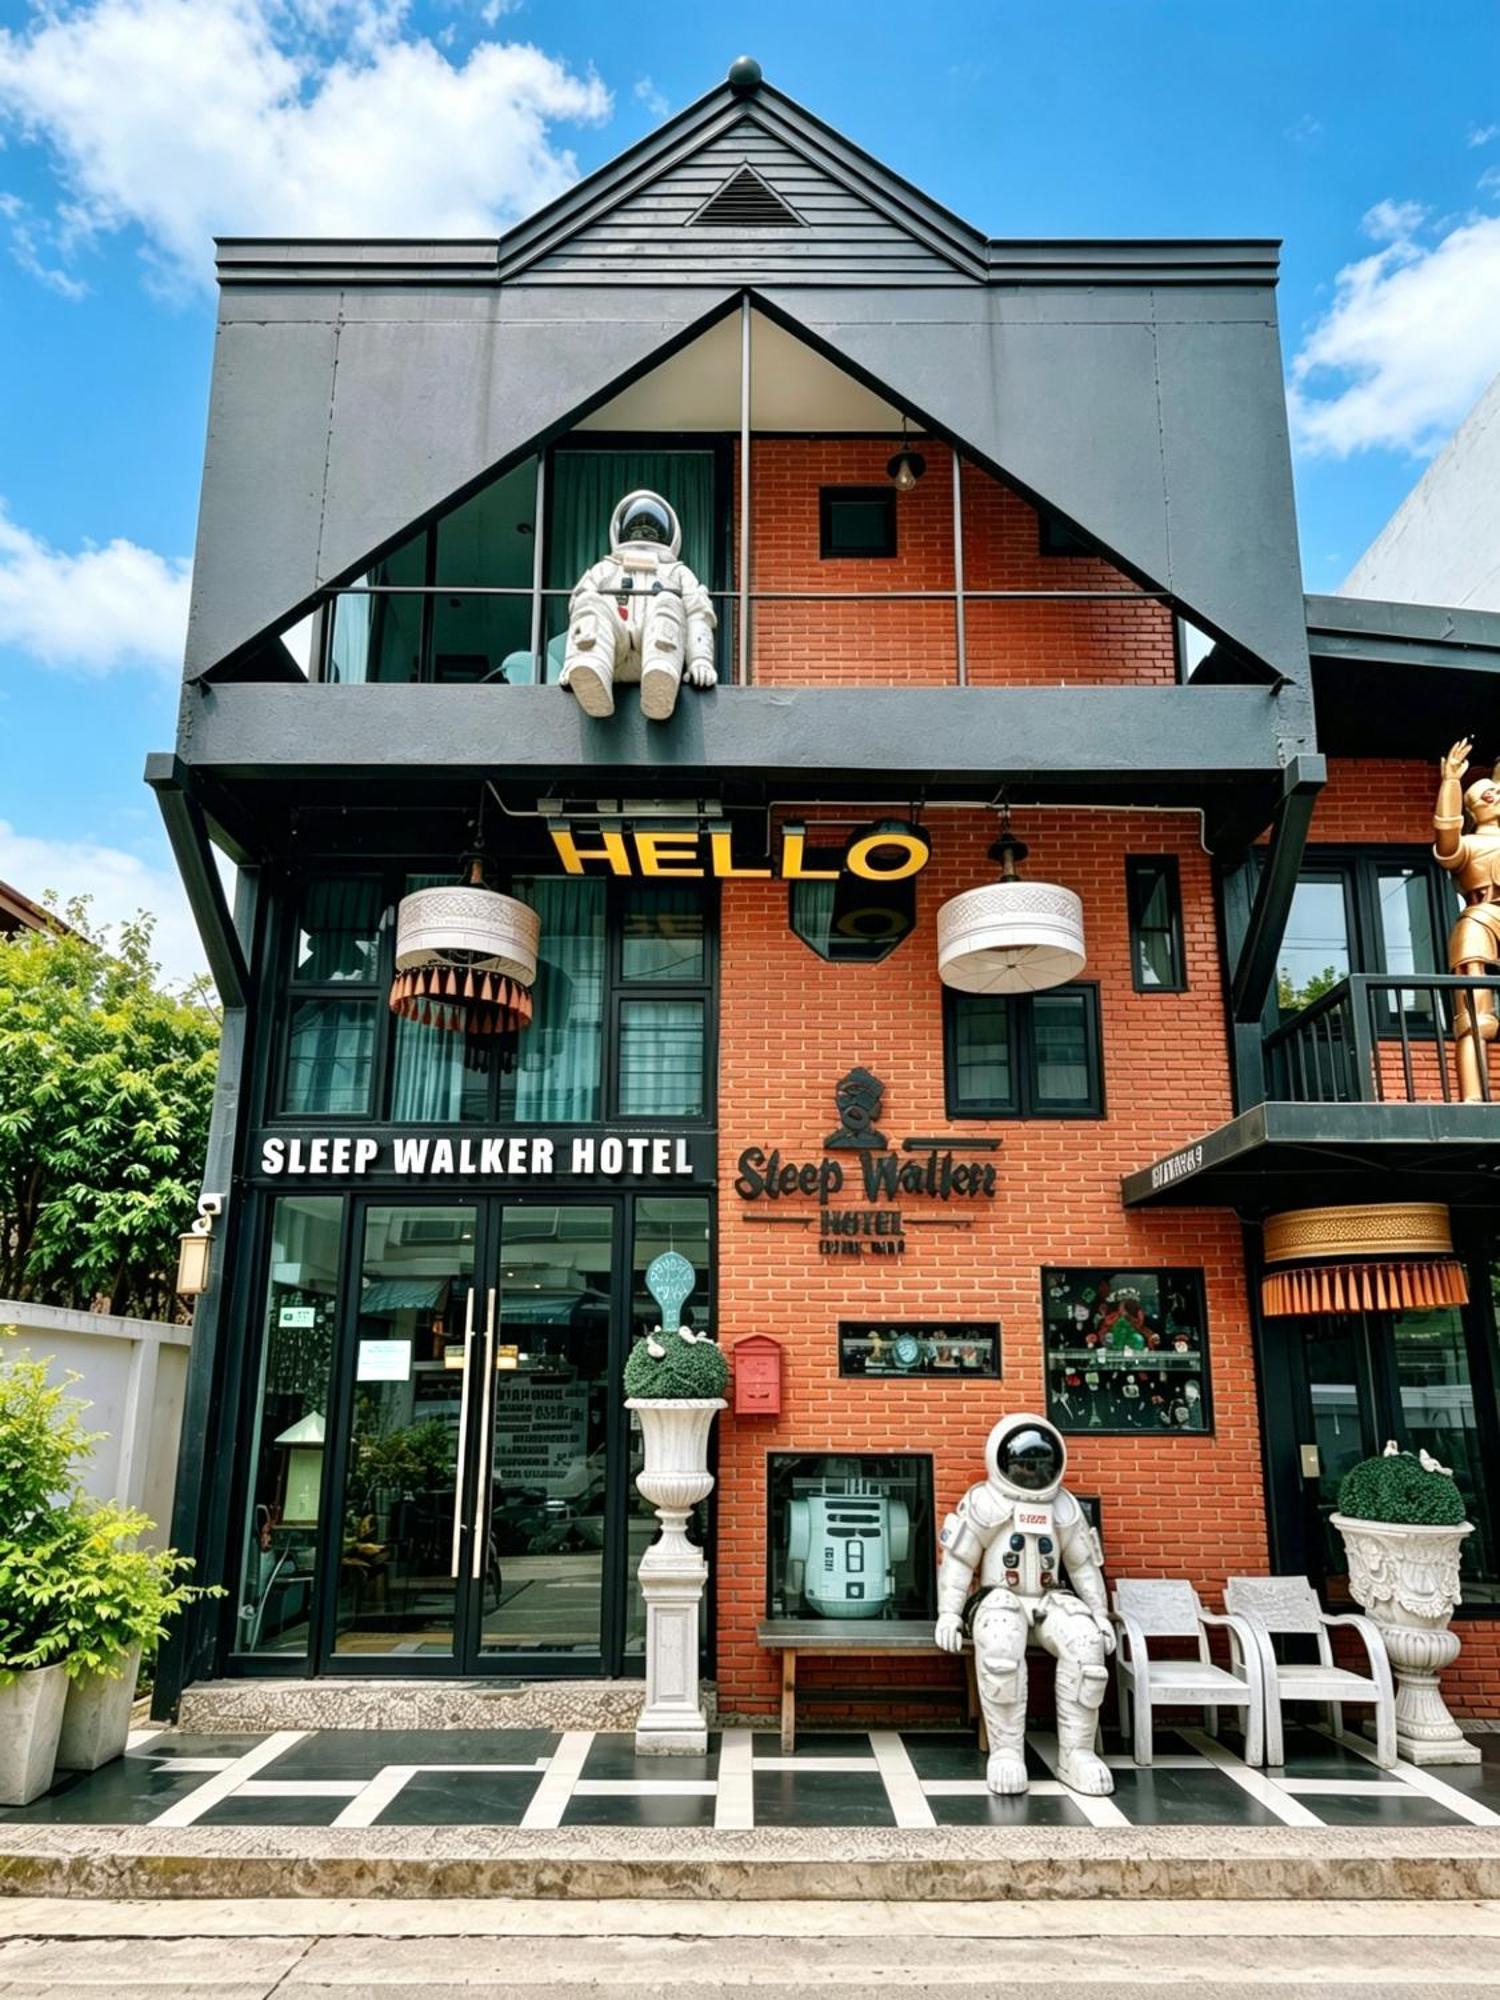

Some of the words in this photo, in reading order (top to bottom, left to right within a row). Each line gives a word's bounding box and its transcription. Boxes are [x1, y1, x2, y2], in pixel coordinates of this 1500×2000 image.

[550, 830, 930, 881] HELLO
[261, 1137, 379, 1175] SLEEP
[393, 1137, 554, 1175] WALKER
[571, 1137, 694, 1175] HOTEL
[734, 1146, 844, 1205] Sleep
